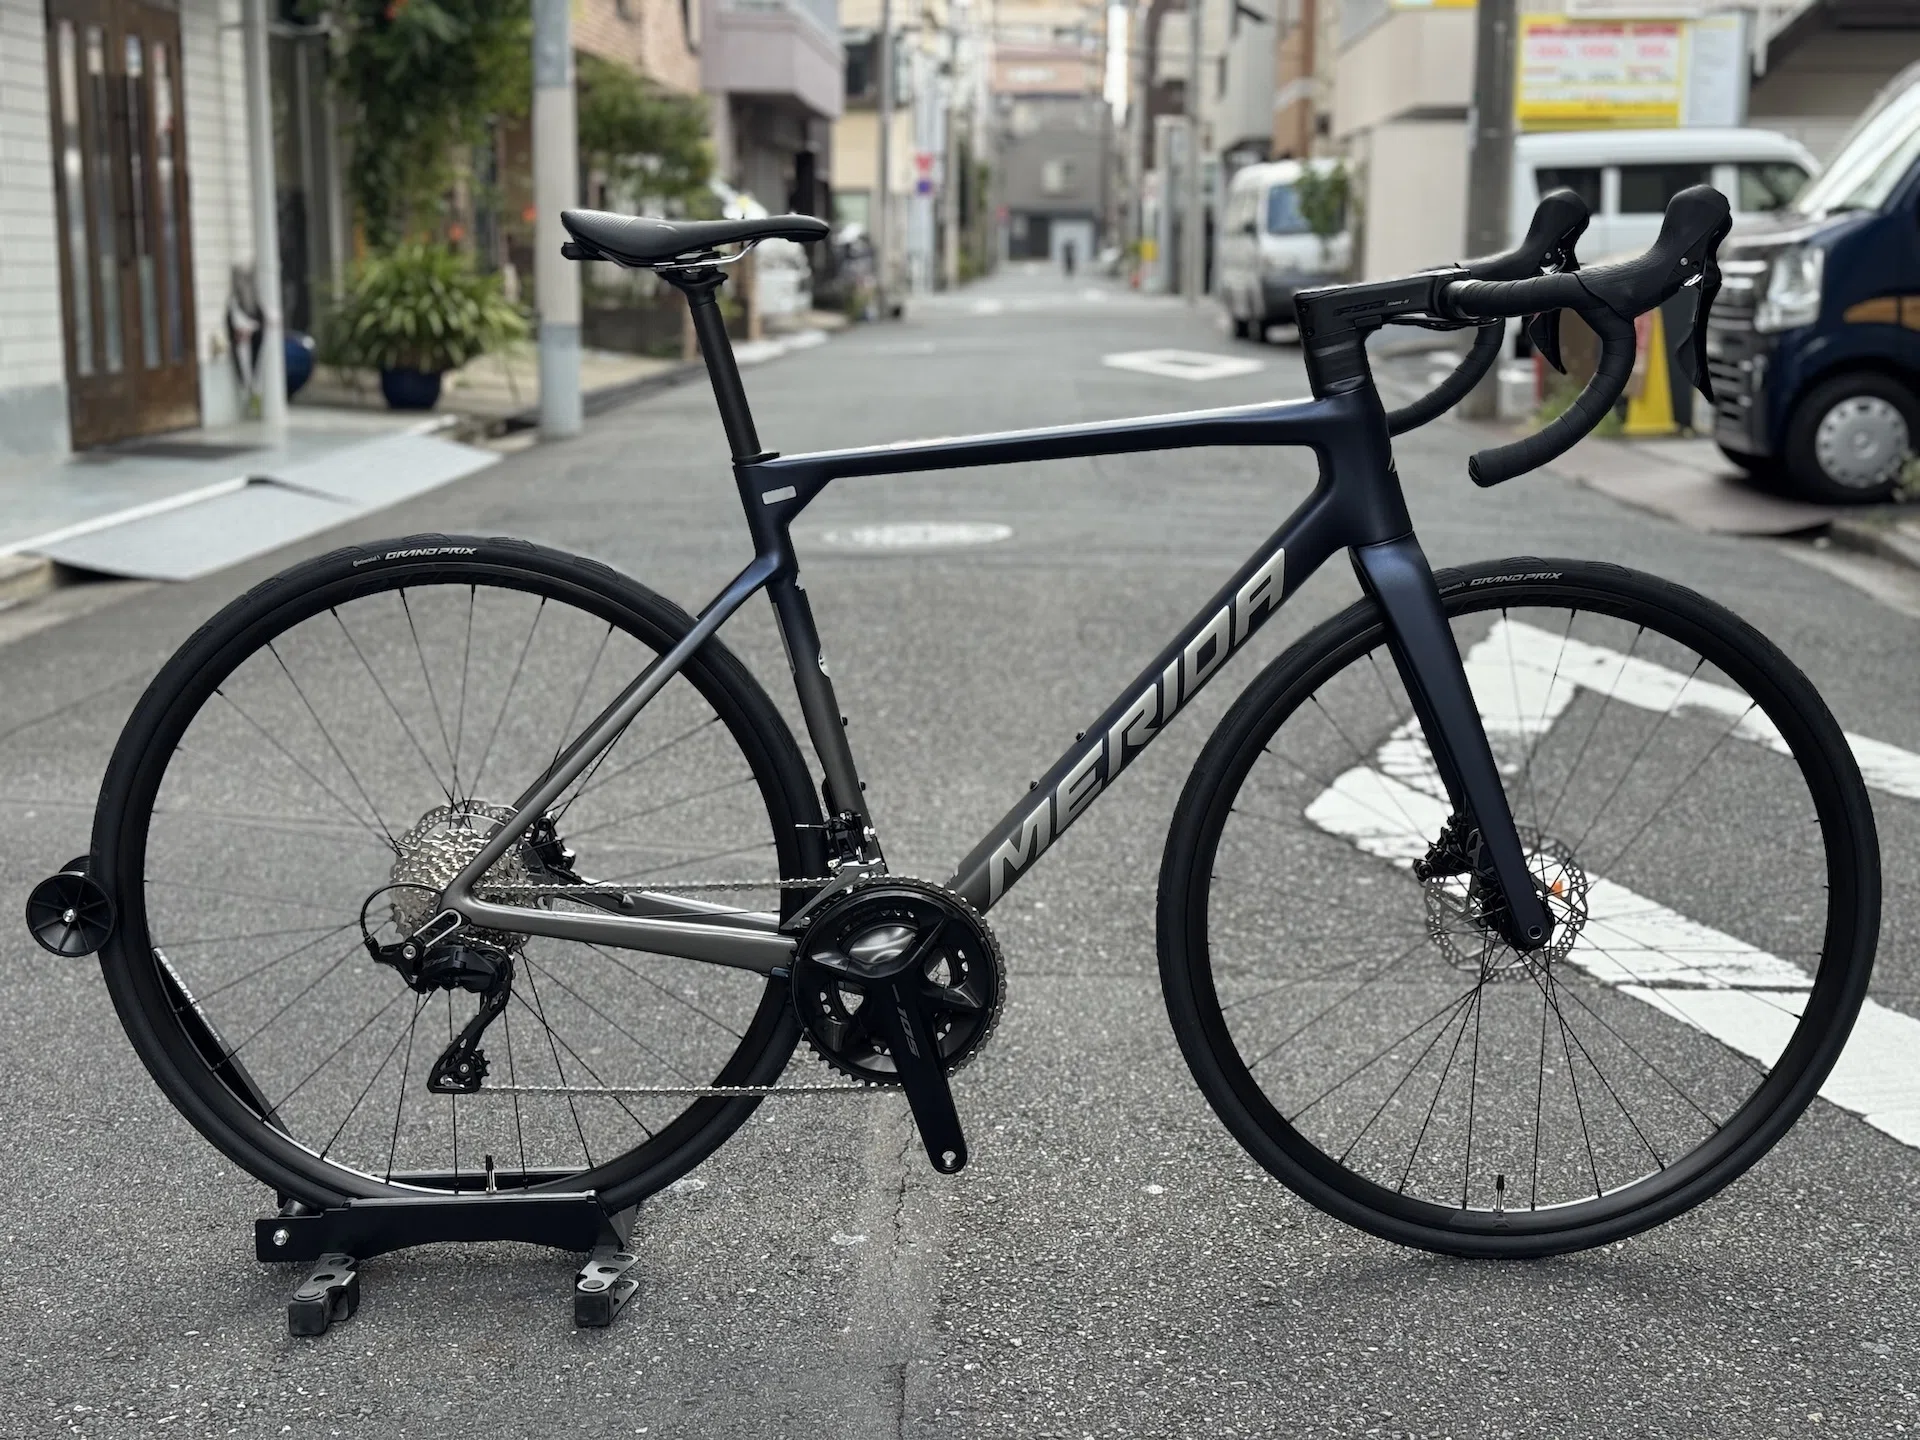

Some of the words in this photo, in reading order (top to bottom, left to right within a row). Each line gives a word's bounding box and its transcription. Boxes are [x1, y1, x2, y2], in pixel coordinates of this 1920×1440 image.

[384, 548, 439, 561] GRAND
[437, 547, 477, 556] PRIX
[1469, 573, 1525, 587] GRAND
[1523, 572, 1563, 581] PRIX
[988, 547, 1286, 907] MERIDA
[897, 1006, 921, 1060] 105
